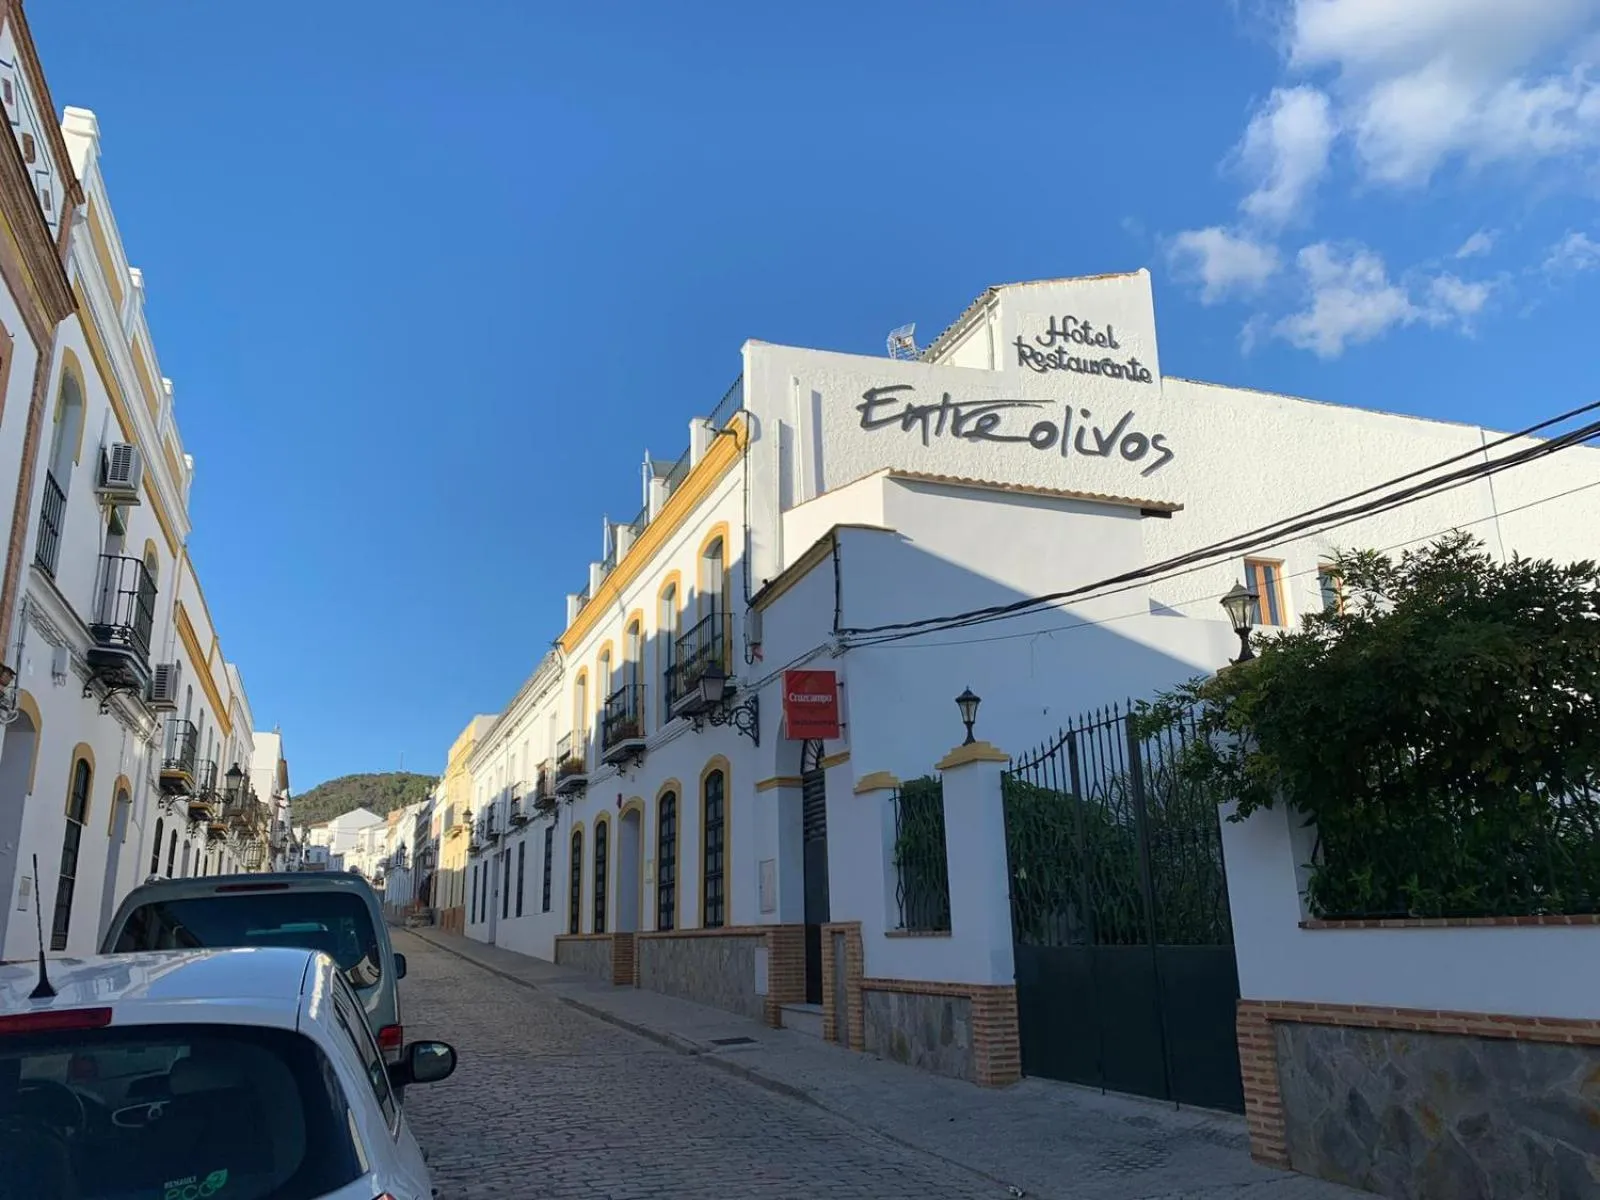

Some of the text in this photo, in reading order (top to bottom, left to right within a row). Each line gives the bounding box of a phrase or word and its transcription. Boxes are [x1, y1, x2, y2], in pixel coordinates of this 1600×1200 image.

[1035, 315, 1120, 349] Hotel
[1012, 335, 1153, 384] Restaurante
[789, 692, 833, 704] Cruzcampo
